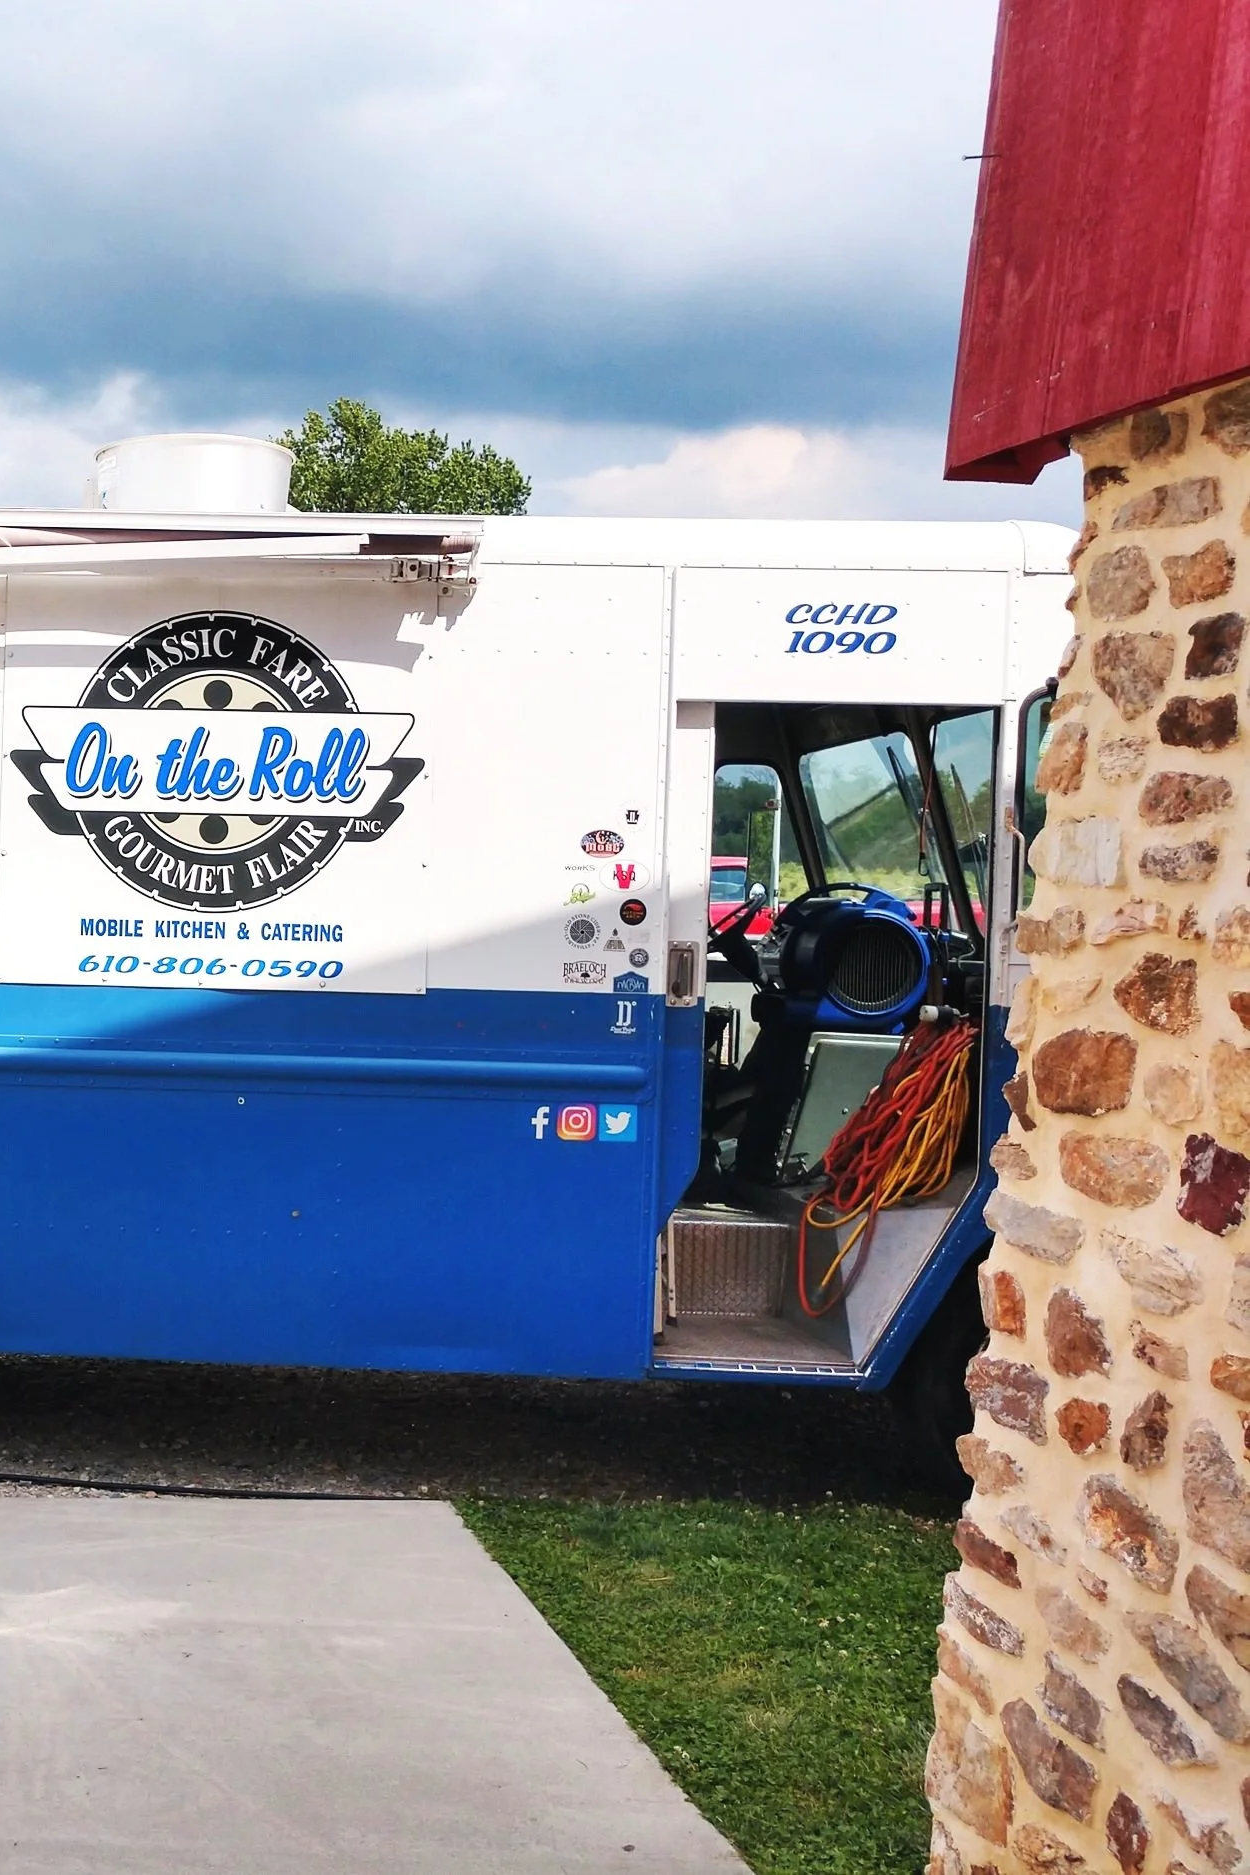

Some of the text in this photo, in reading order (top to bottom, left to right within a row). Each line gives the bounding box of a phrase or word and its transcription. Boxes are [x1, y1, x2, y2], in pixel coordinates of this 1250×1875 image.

[784, 602, 898, 625] CCHD
[784, 631, 897, 654] 1090
[106, 628, 330, 709] CLASSIC FARE
[64, 722, 371, 804] On the Roll
[354, 818, 386, 834] INC.
[103, 815, 329, 896] GOURMET FLAIR
[79, 917, 344, 942] MOBILE KITCHEN & CATERING
[78, 954, 344, 979] 610-806-0590
[563, 962, 607, 978] BRAELOCH
